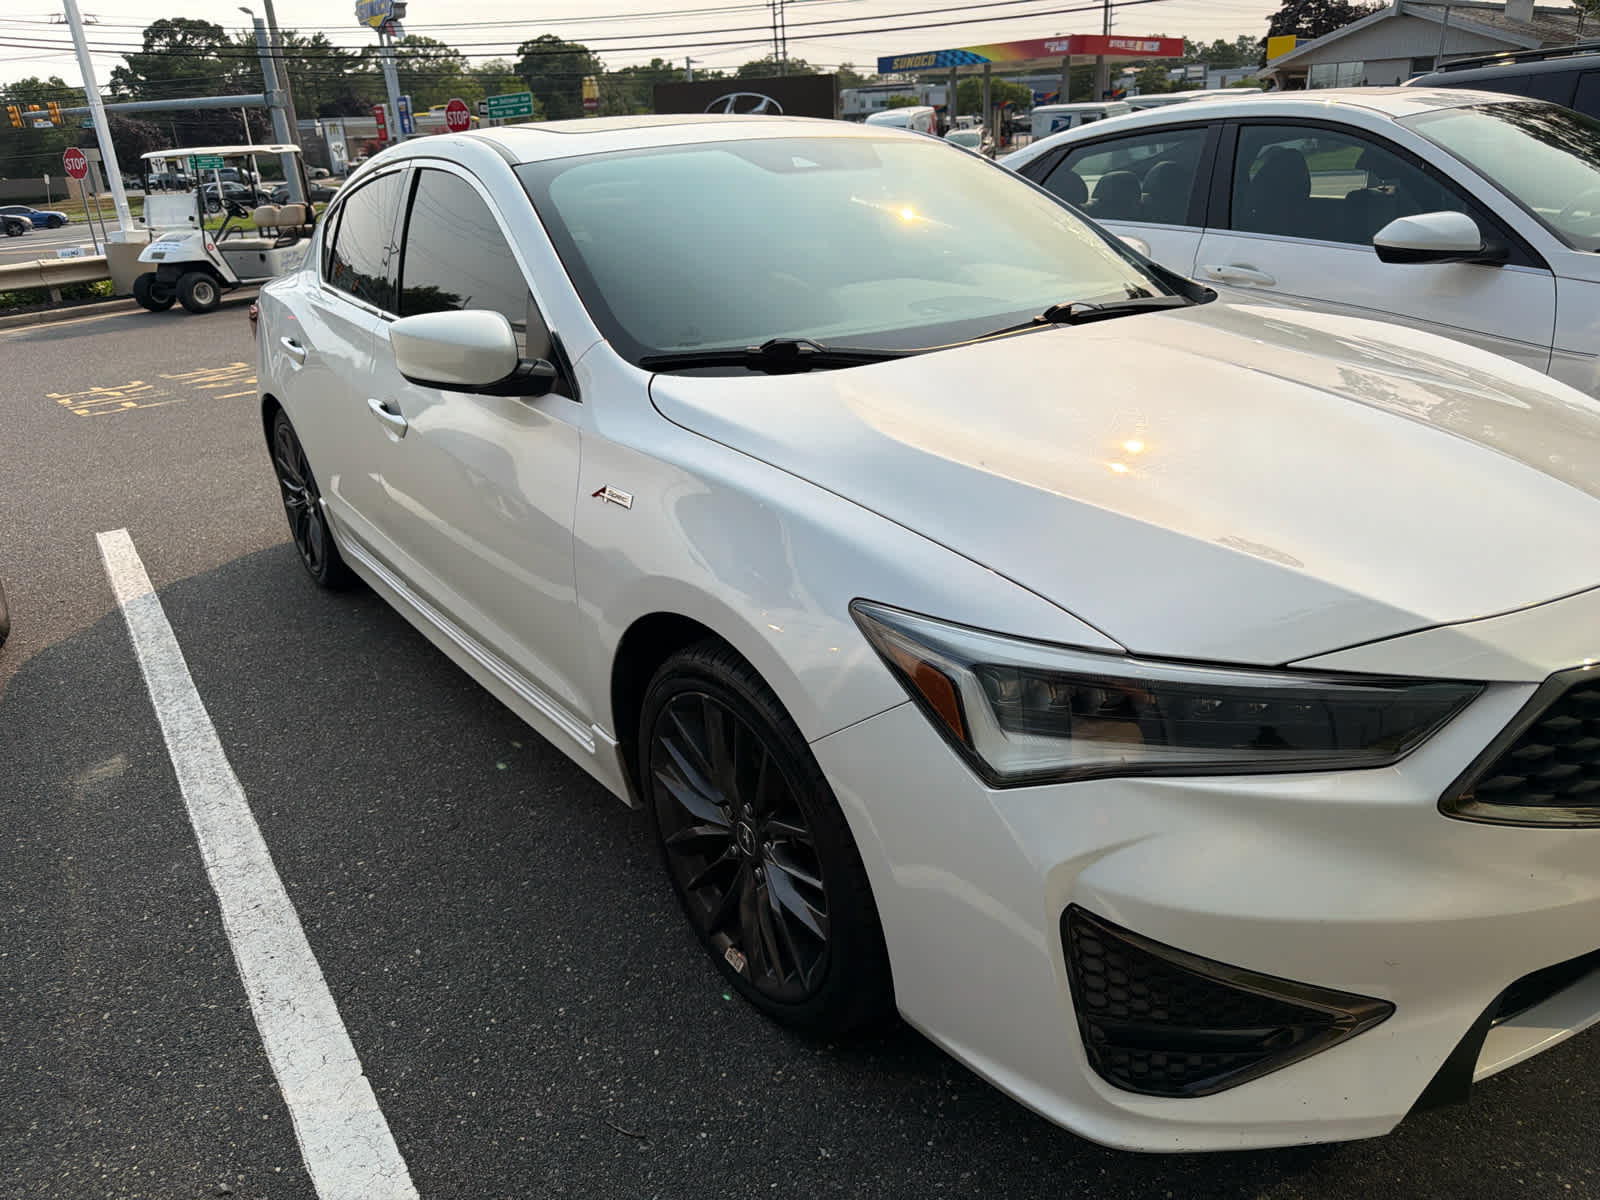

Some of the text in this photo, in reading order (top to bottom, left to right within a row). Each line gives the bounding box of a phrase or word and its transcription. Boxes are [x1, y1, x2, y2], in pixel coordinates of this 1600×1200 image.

[891, 54, 937, 69] SUNOCO
[447, 110, 469, 125] STOP
[65, 158, 86, 171] STOP
